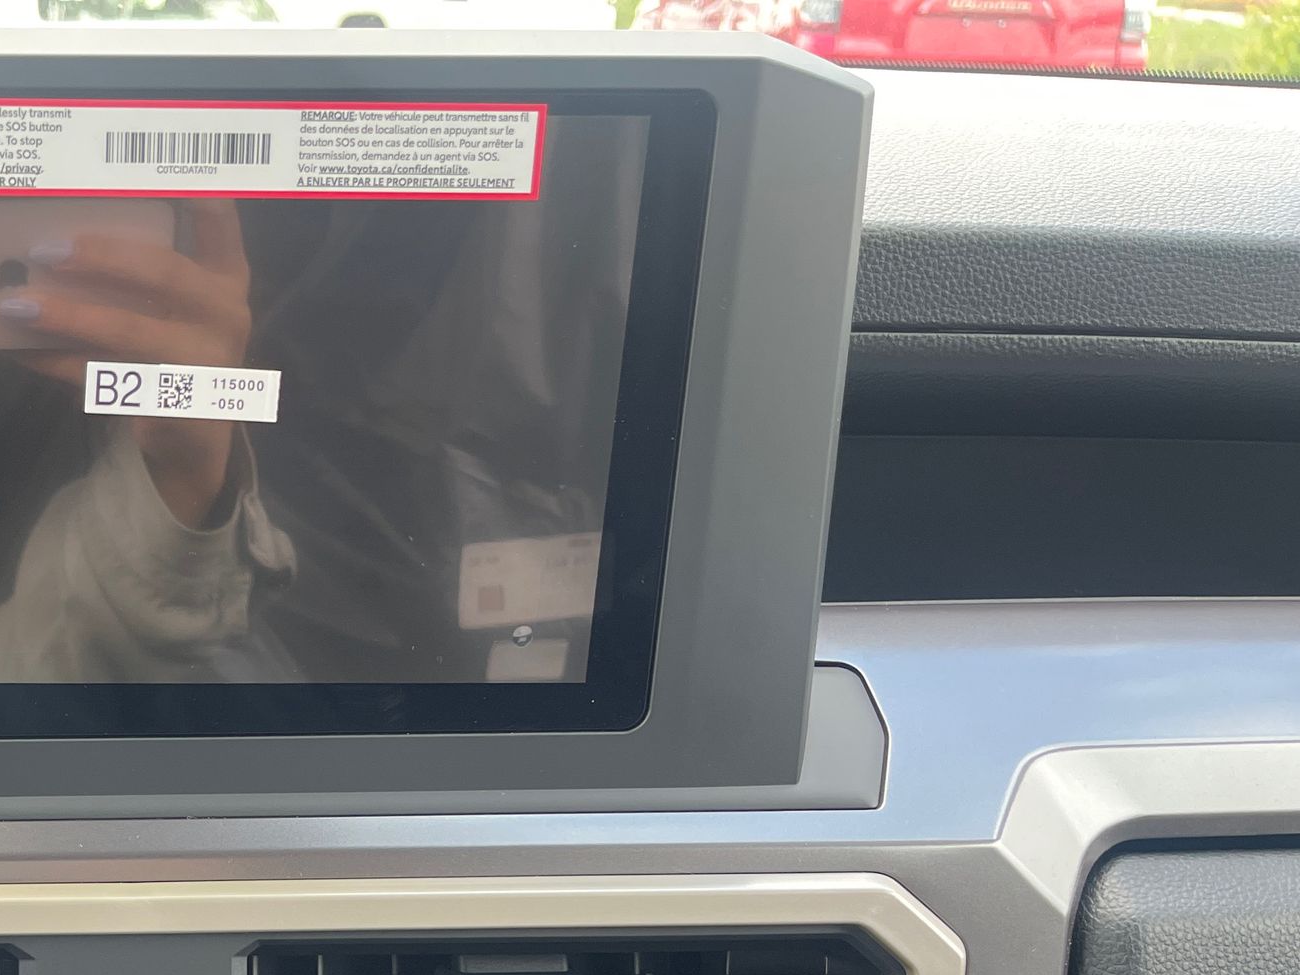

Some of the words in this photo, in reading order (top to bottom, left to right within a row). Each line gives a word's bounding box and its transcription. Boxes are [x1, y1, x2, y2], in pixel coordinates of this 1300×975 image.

[29, 109, 72, 118] transmit
[300, 111, 358, 122] REMARQUE:
[359, 112, 383, 121] Votre
[384, 112, 421, 121] véhicule
[422, 113, 444, 123] peut
[445, 113, 497, 122] transmettre
[498, 114, 519, 122] sans
[520, 112, 530, 122] fil
[5, 121, 27, 132] SOS
[28, 122, 62, 132] button
[300, 124, 317, 134] des
[319, 124, 360, 134] données
[361, 125, 374, 134] de
[375, 125, 428, 135] localisation
[430, 127, 442, 135] en
[443, 127, 488, 137] appuyant
[505, 126, 515, 135] le
[5, 136, 17, 145] To
[20, 137, 43, 148] stop
[299, 137, 334, 147] bouton
[335, 137, 356, 147] SOS
[402, 138, 415, 147] de
[416, 138, 457, 149] collision.
[459, 139, 481, 148] Pour
[482, 139, 514, 149] arrêter
[515, 139, 524, 149] la
[0, 150, 14, 160] via
[16, 149, 41, 160] SOS.
[299, 151, 360, 162] transmission,
[361, 151, 412, 161] demandez
[412, 152, 418, 161] à
[420, 153, 432, 161] un
[434, 153, 461, 163] agent
[462, 152, 476, 161] via
[478, 152, 500, 162] SOS.
[298, 164, 317, 173] Voir
[8, 176, 37, 188] ONLY
[296, 176, 304, 187] A
[307, 176, 350, 188] ENLEVER
[352, 177, 370, 188] PAR
[373, 177, 384, 188] LE
[386, 177, 455, 188] PROPRIETAIRE
[457, 178, 515, 189] SEULEMENT
[95, 370, 142, 408] B2
[211, 378, 265, 392] 115000
[211, 398, 244, 411] -050
